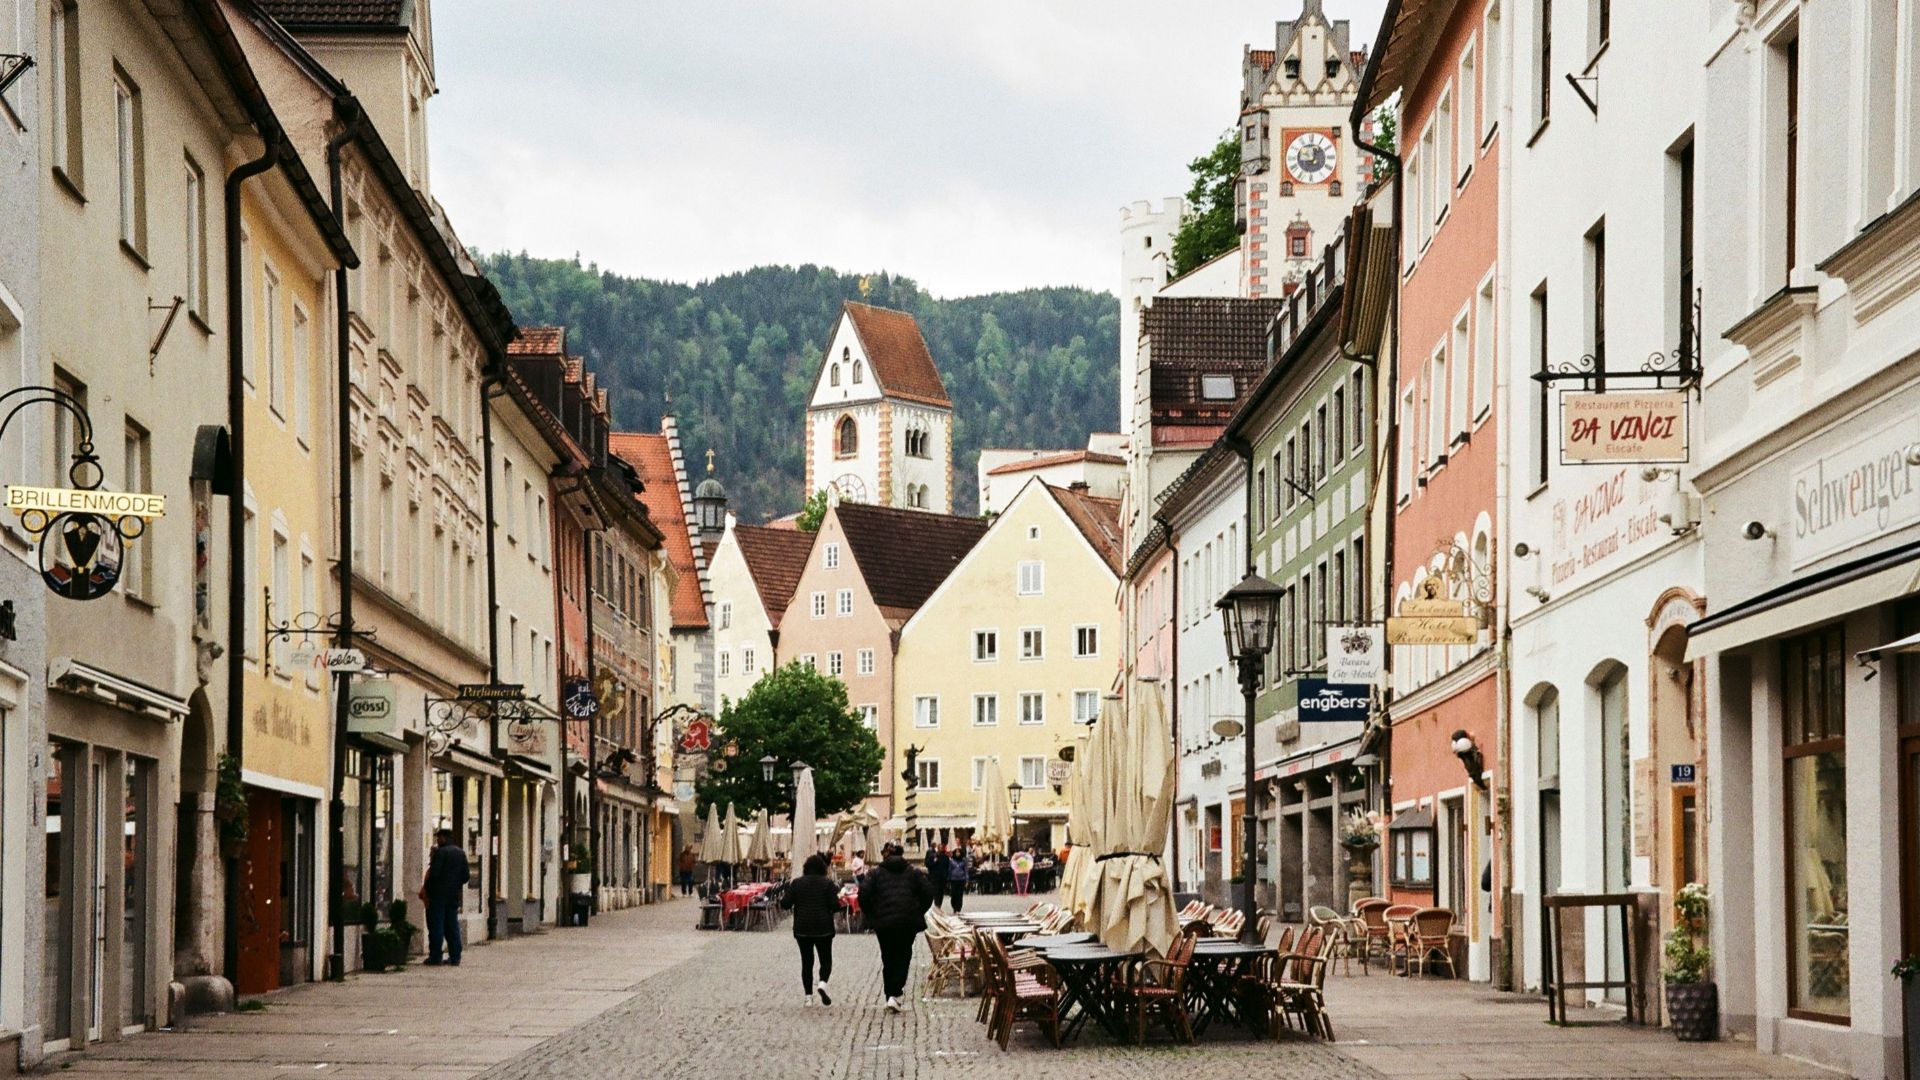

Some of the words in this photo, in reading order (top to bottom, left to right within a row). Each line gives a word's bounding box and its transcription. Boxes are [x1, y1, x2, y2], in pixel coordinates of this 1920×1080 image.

[1574, 400, 1631, 410] Restaurant
[1634, 398, 1674, 409] Pizzeria
[1571, 417, 1601, 446] DA
[1610, 410, 1677, 442] VINCI
[11, 489, 163, 513] BRILLENMODE
[1409, 617, 1456, 630] Hotel
[1339, 657, 1370, 666] Bavaria
[1300, 695, 1367, 712] engbers
[1678, 766, 1691, 777] 19
